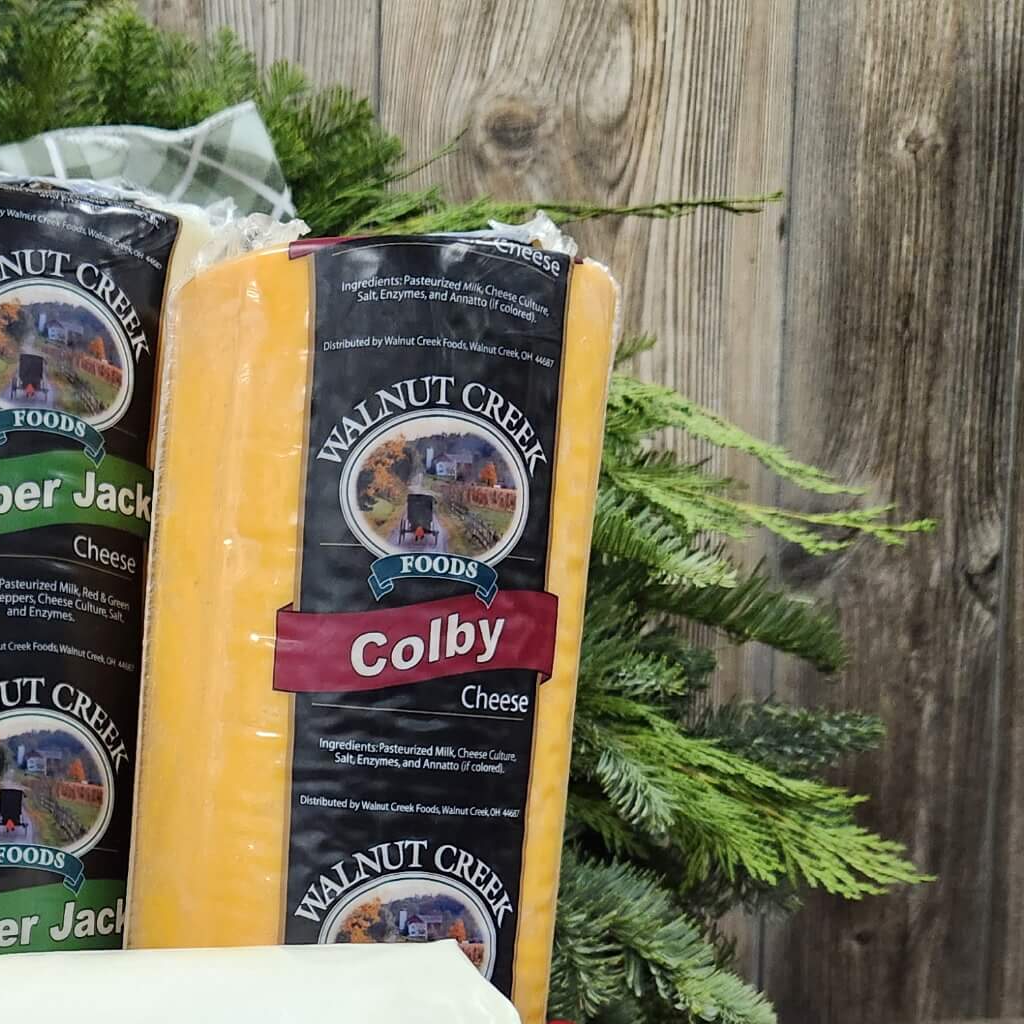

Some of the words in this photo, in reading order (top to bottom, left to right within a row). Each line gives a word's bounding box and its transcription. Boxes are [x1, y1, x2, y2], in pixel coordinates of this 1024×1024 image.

[341, 276, 402, 293] Ingredients:
[404, 276, 461, 290] Pasteurized
[485, 284, 517, 304] Cheese
[380, 289, 427, 302] Enzymes,
[429, 289, 447, 300] and
[449, 292, 488, 308] Annatto
[76, 262, 151, 364] CREEK
[12, 410, 87, 437] FOODS
[316, 375, 455, 464] WALNUT
[462, 382, 548, 478] CREEK
[73, 472, 151, 521] Jack
[73, 536, 136, 573] Cheese
[400, 557, 478, 579] FOODS
[7, 607, 26, 616] and
[38, 593, 73, 607] Cheese
[82, 587, 98, 599] Red
[108, 594, 129, 611] Green
[350, 613, 505, 677] Colby
[461, 685, 529, 713] Cheese
[52, 683, 129, 774] CREEK
[295, 840, 428, 924] WALNUT
[434, 844, 514, 928] CREEK
